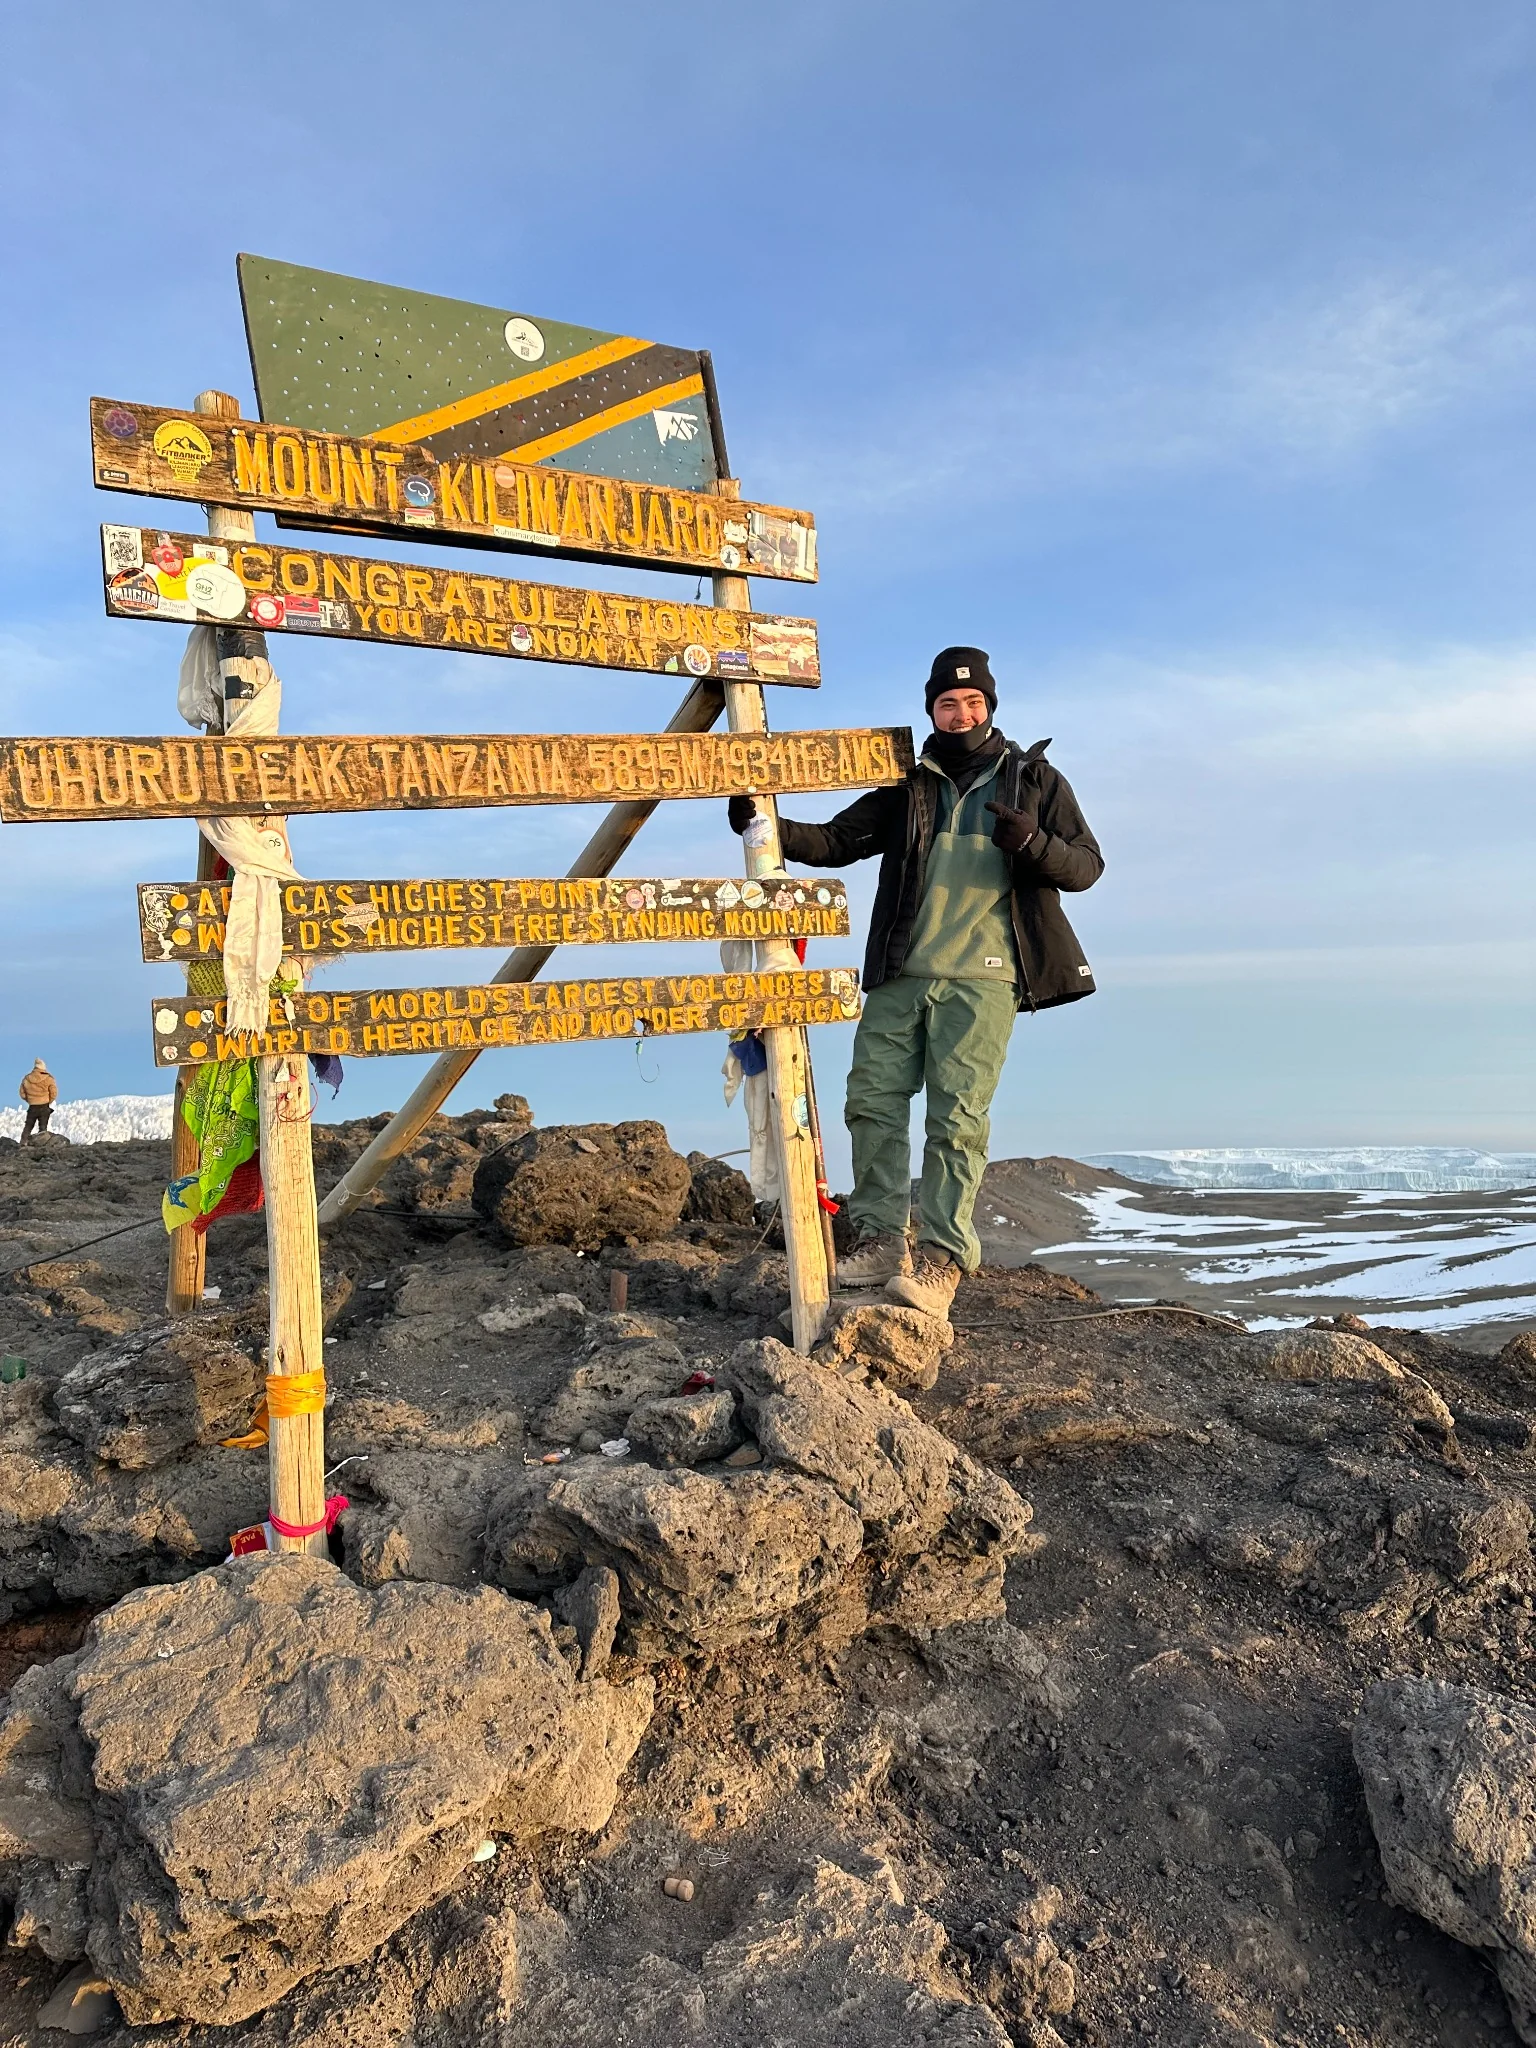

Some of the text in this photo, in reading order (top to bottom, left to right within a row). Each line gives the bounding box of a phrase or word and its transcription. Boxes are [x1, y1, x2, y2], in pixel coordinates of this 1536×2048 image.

[161, 449, 207, 460] FITBANKER
[232, 429, 720, 558] MOUNT KILIMANJARO
[233, 546, 742, 648] CONGRATULATIONS
[355, 603, 657, 668] YOU ARE NOW AT
[720, 663, 749, 671] patagonia
[16, 742, 202, 809] UHURU
[838, 735, 907, 782] AMSL
[198, 884, 356, 917] AFCA'S
[369, 882, 505, 913] HIGHEST
[520, 880, 605, 910] POINT
[367, 912, 504, 947] HIGHEST
[724, 908, 838, 936] MOUNTAIN
[214, 998, 289, 1028] OE
[308, 995, 354, 1023] OF
[523, 979, 656, 1012] LARGEST
[670, 972, 824, 1003] VOLCANOES
[216, 1026, 351, 1060] WORLD
[363, 1016, 520, 1052] HERITAGE
[531, 1012, 585, 1040] AND
[719, 1002, 750, 1027] OF
[762, 998, 844, 1024] AFRICA
